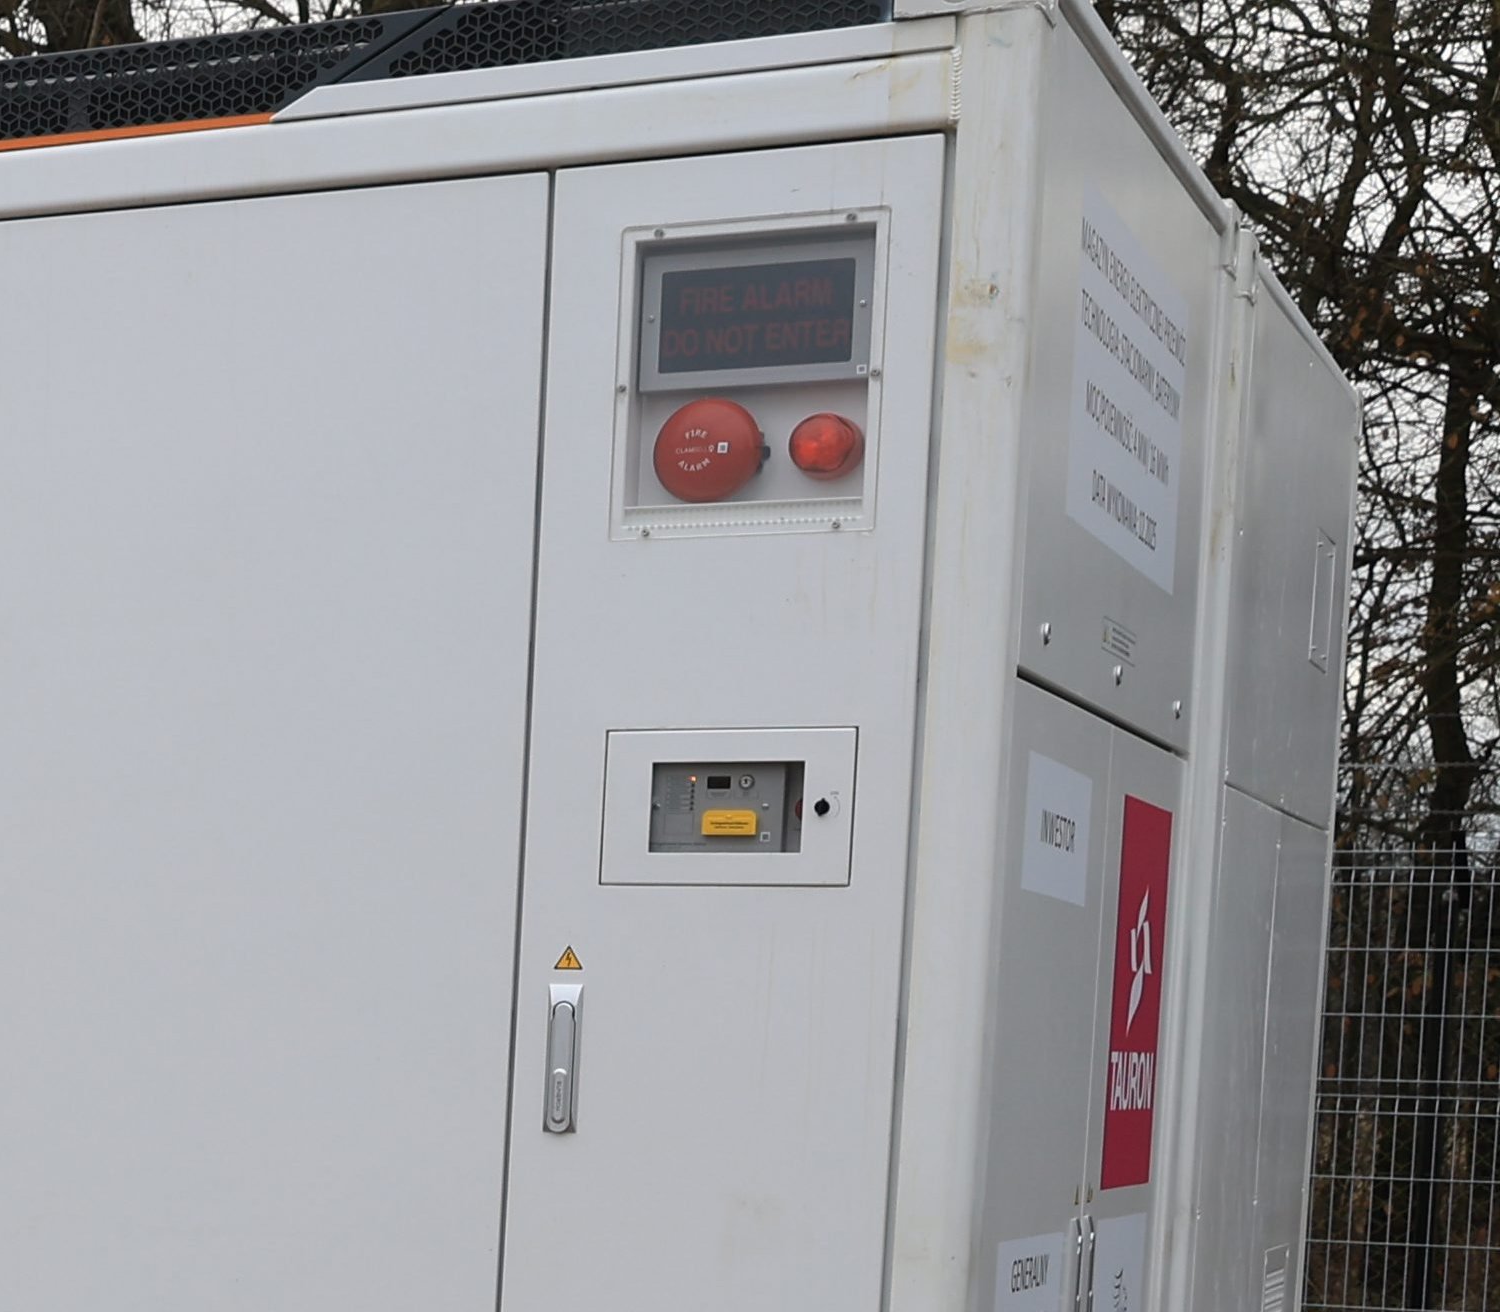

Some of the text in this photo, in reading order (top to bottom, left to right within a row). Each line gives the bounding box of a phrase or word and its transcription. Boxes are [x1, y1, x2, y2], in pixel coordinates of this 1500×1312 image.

[680, 278, 833, 315] FIRE ALARM
[663, 318, 849, 357] DO NOT ENTER
[684, 428, 709, 440] FIRE
[677, 457, 711, 472] ALARM
[1040, 808, 1076, 854] INWESTOR
[1110, 1051, 1154, 1111] TAURON
[1010, 1253, 1050, 1293] GENERALNY
